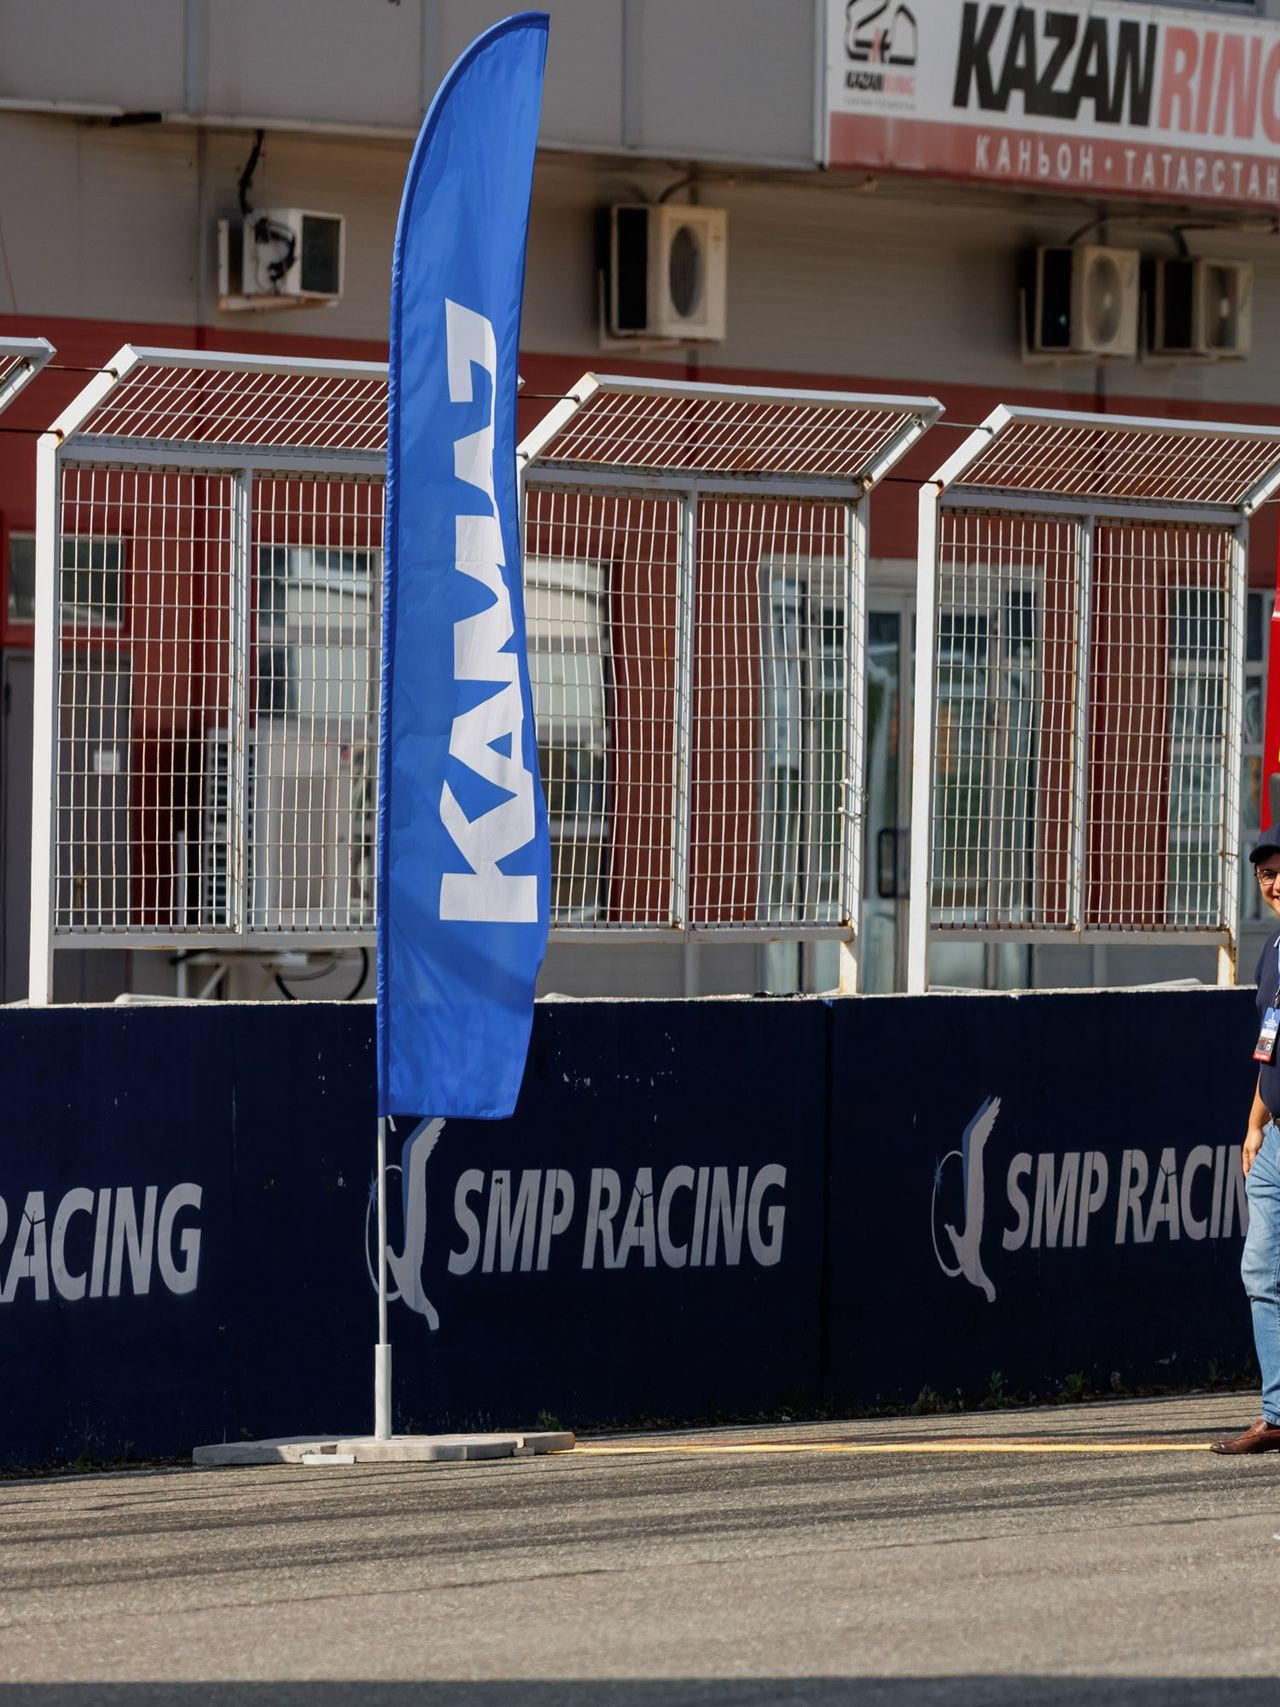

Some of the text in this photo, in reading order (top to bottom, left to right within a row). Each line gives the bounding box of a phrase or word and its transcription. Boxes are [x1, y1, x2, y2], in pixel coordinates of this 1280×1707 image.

[975, 134, 1279, 197] КАНЬОН ТАТАРСТАН
[439, 297, 538, 923] KAMAZ
[446, 1163, 787, 1276] SMP RACING
[1002, 1145, 1249, 1251] SMP RACIN
